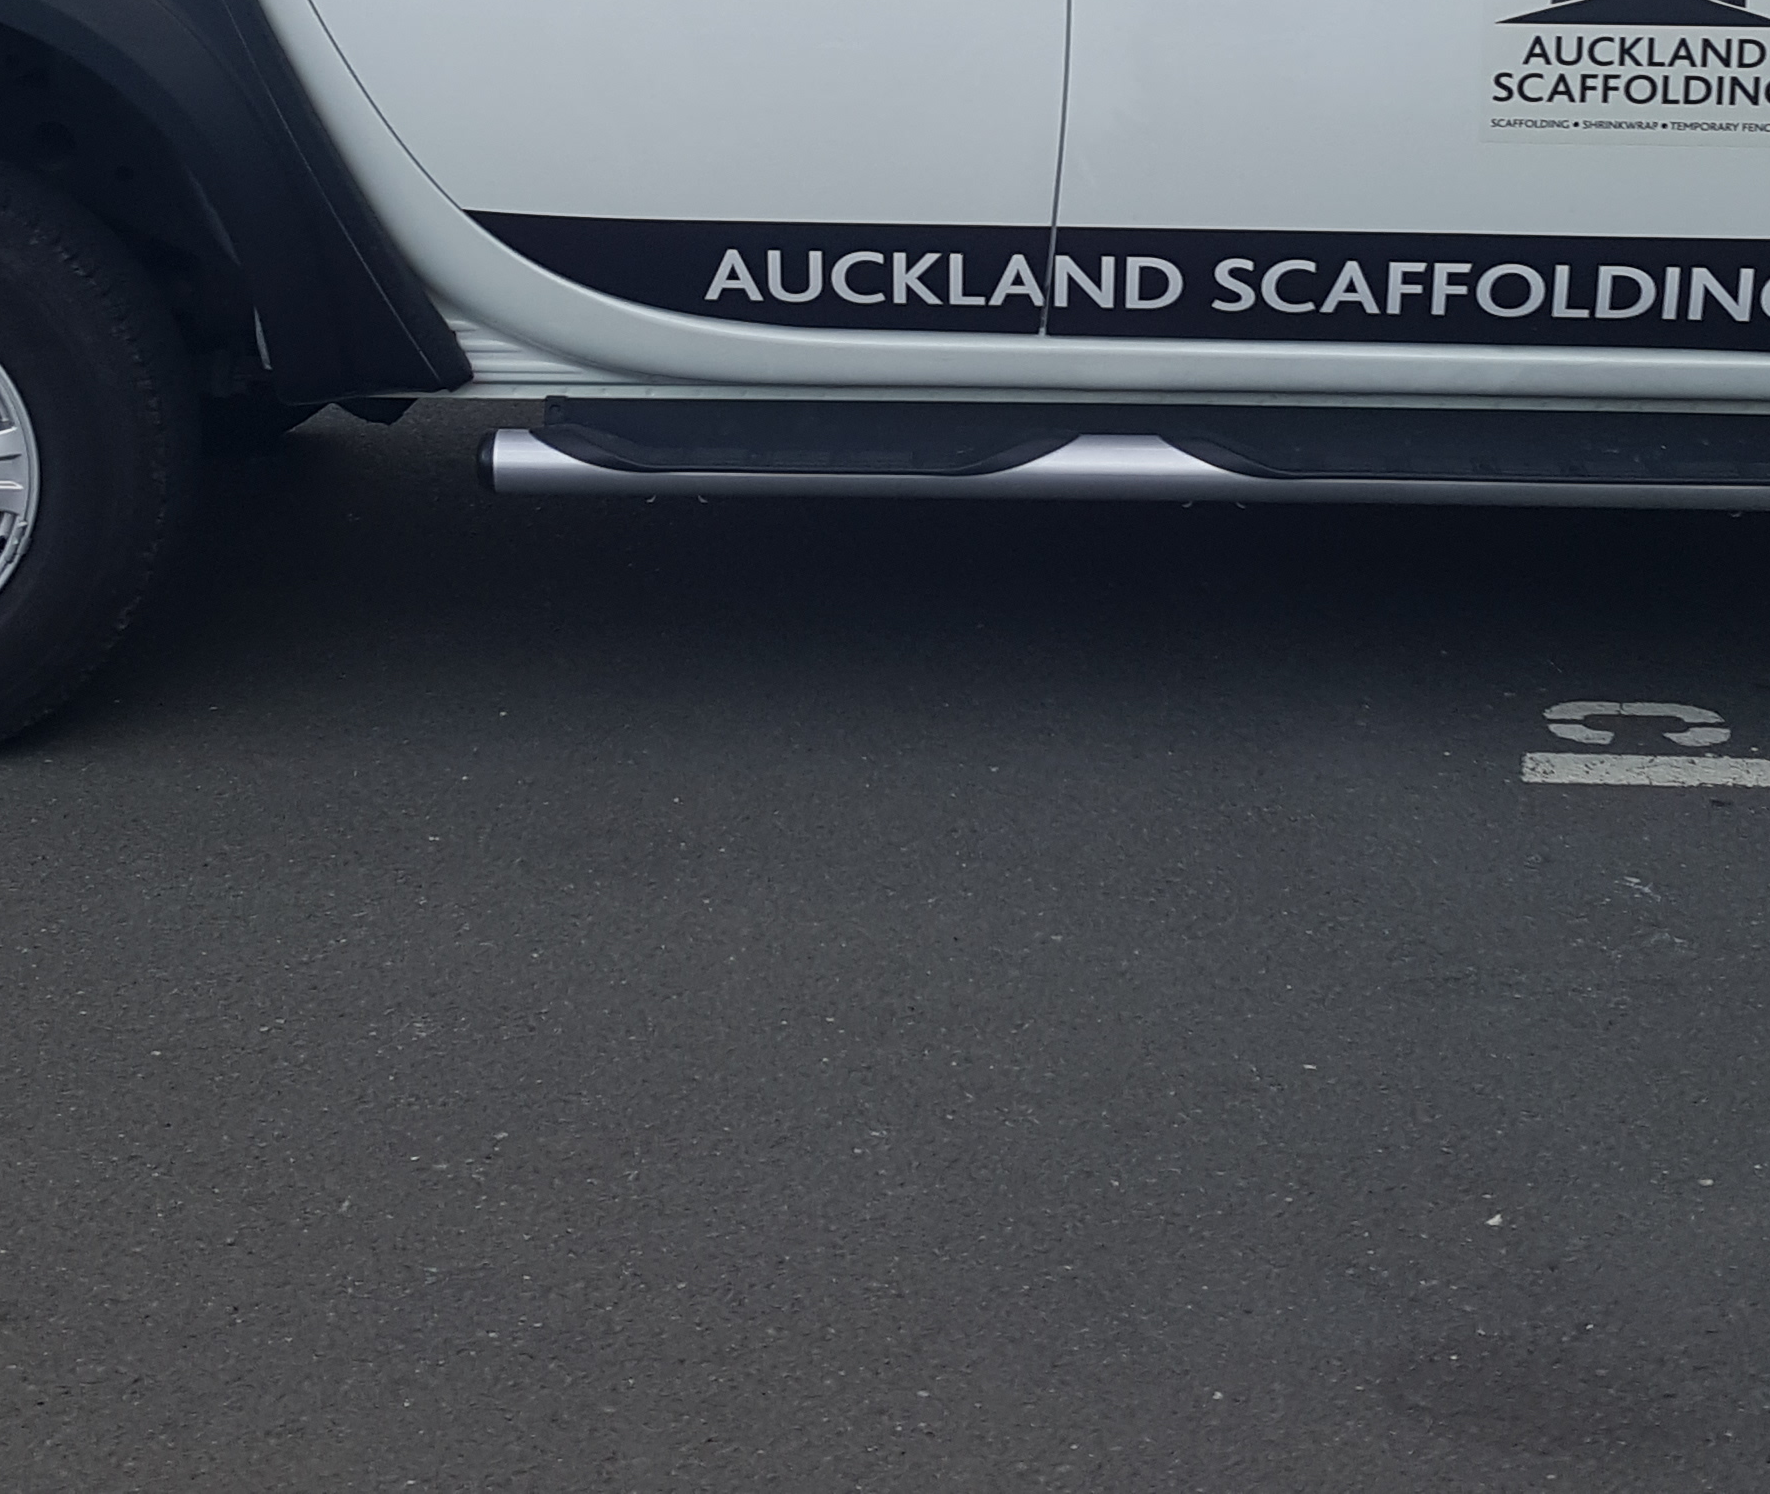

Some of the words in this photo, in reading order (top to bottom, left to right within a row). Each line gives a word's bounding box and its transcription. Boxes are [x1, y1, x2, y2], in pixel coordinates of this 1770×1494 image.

[1522, 35, 1767, 69] AUCKLAND
[1490, 118, 1571, 130] SCAFFOLDING
[1582, 119, 1659, 131] SHRINKWRAP
[1670, 121, 1740, 133] TEMPORARY
[704, 248, 1185, 311] AUCKLAND
